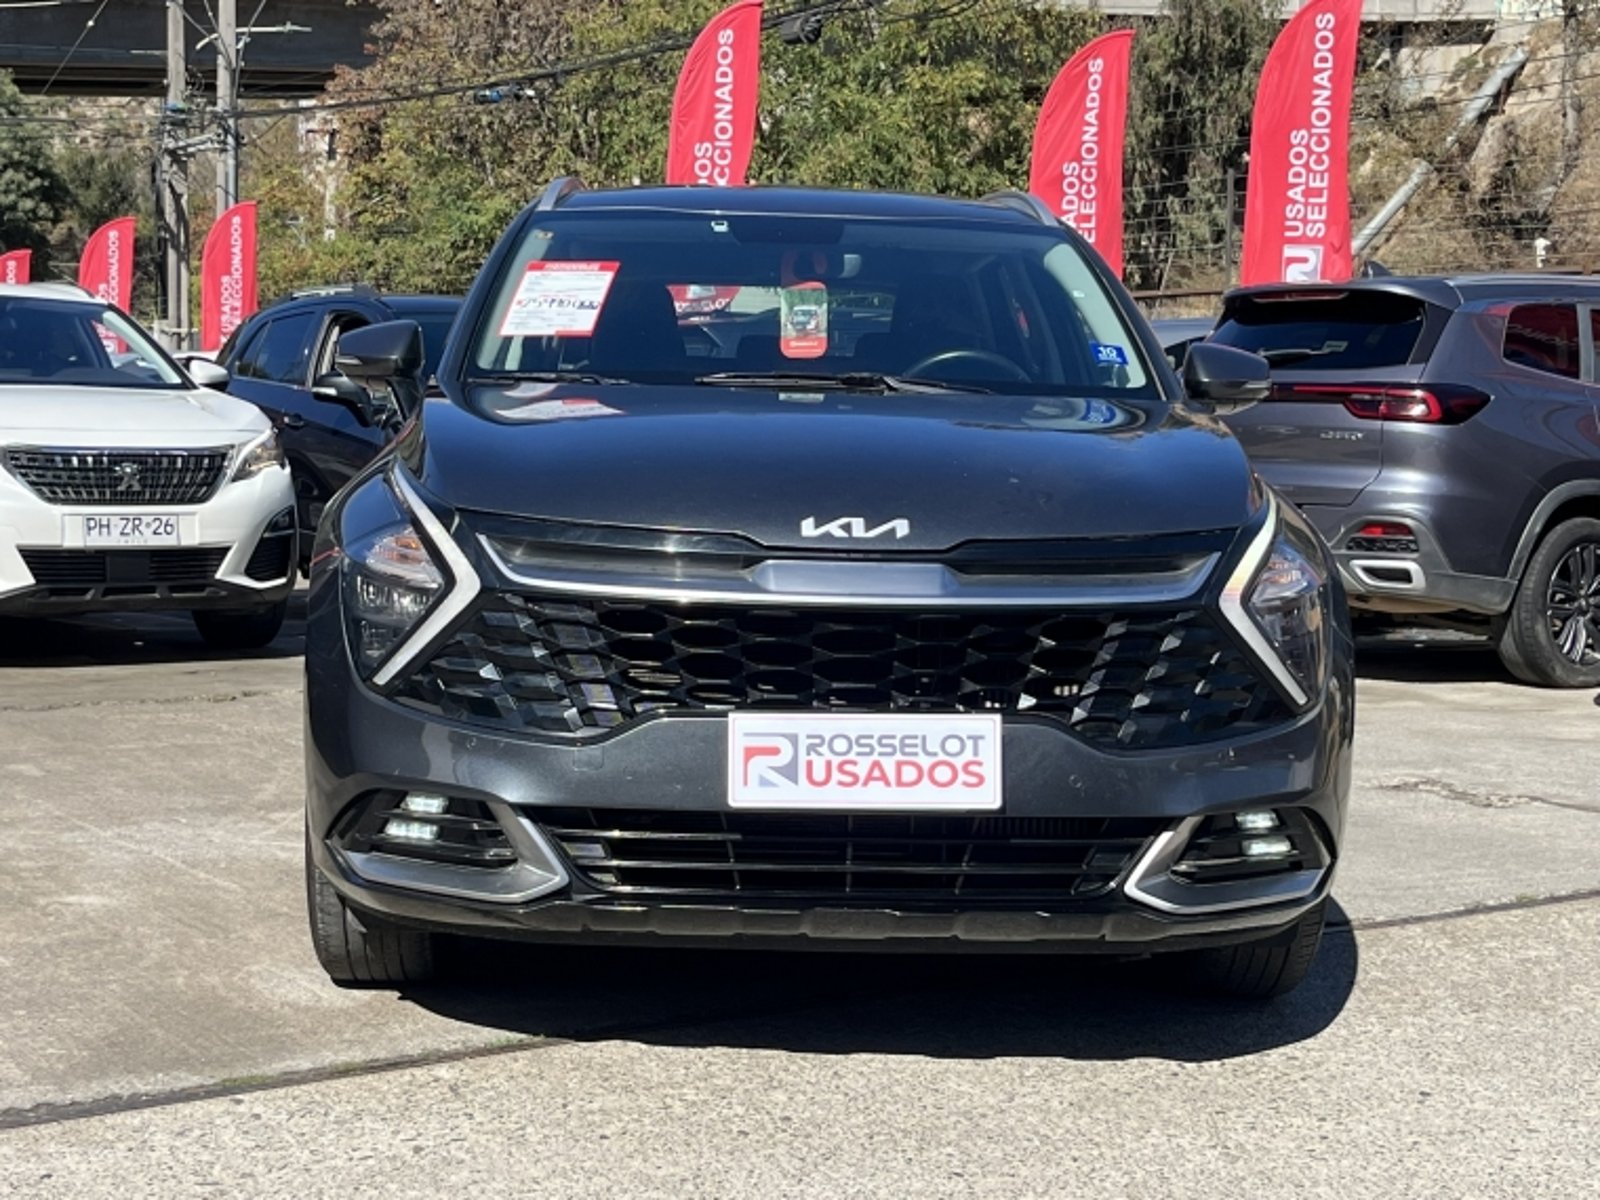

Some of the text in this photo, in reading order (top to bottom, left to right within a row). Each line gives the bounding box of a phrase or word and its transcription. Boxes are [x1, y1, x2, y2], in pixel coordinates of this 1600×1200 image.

[713, 28, 734, 186] CCIONADOS
[1079, 57, 1104, 244] ELECCIONADOS
[1306, 12, 1335, 238] SELECCIONADOS
[1061, 160, 1080, 231] ADOS
[1284, 129, 1309, 237] USADOS
[805, 734, 985, 757] ROSSELOT
[805, 759, 986, 788] USADOS
